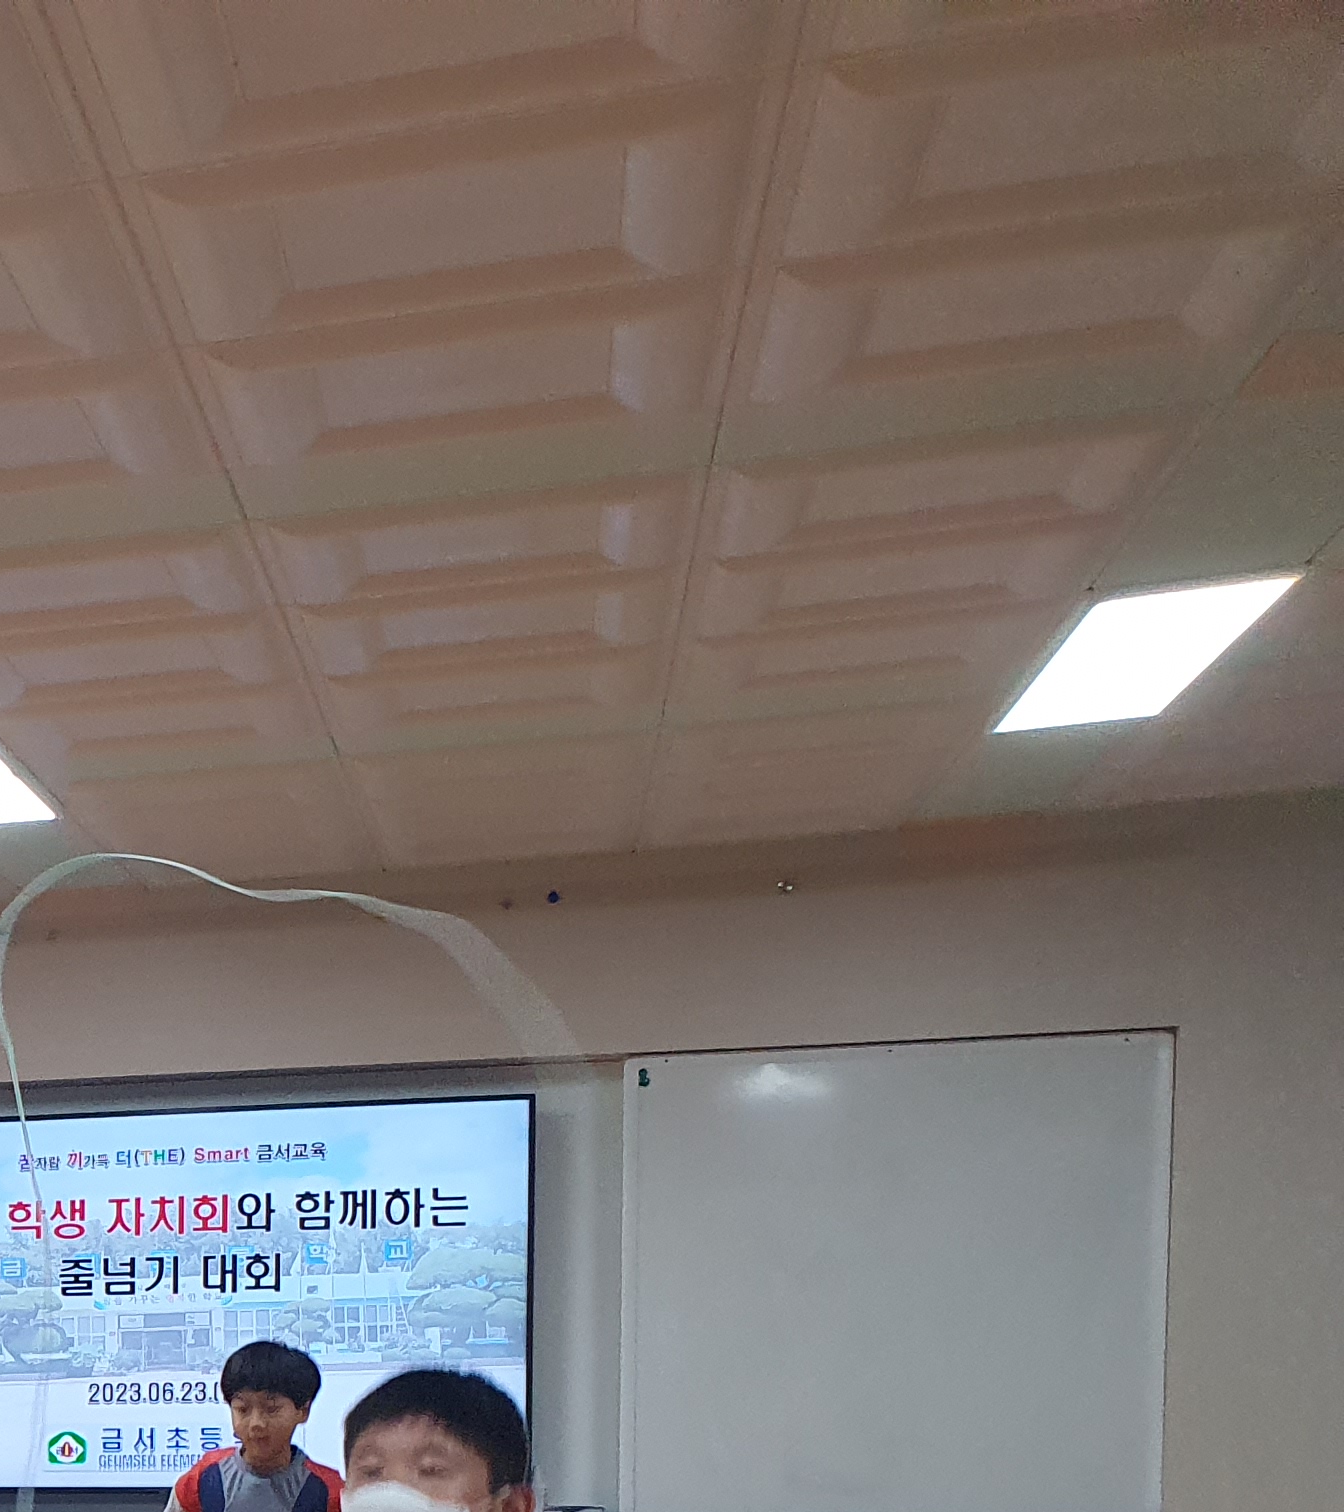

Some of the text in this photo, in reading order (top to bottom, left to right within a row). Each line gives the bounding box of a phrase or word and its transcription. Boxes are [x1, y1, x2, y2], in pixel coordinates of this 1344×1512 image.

[115, 1147, 186, 1168] 더(THE)
[194, 1147, 250, 1163] Smart
[256, 1142, 327, 1162] 금서교육
[8, 1199, 87, 1240] 학생
[107, 1192, 276, 1237] 자치회와
[295, 1187, 469, 1231] 함께하는
[59, 1252, 282, 1296] 줄넘기 대회
[88, 1382, 220, 1404] 2023.06.23.(
[100, 1427, 242, 1453] 금서초등
